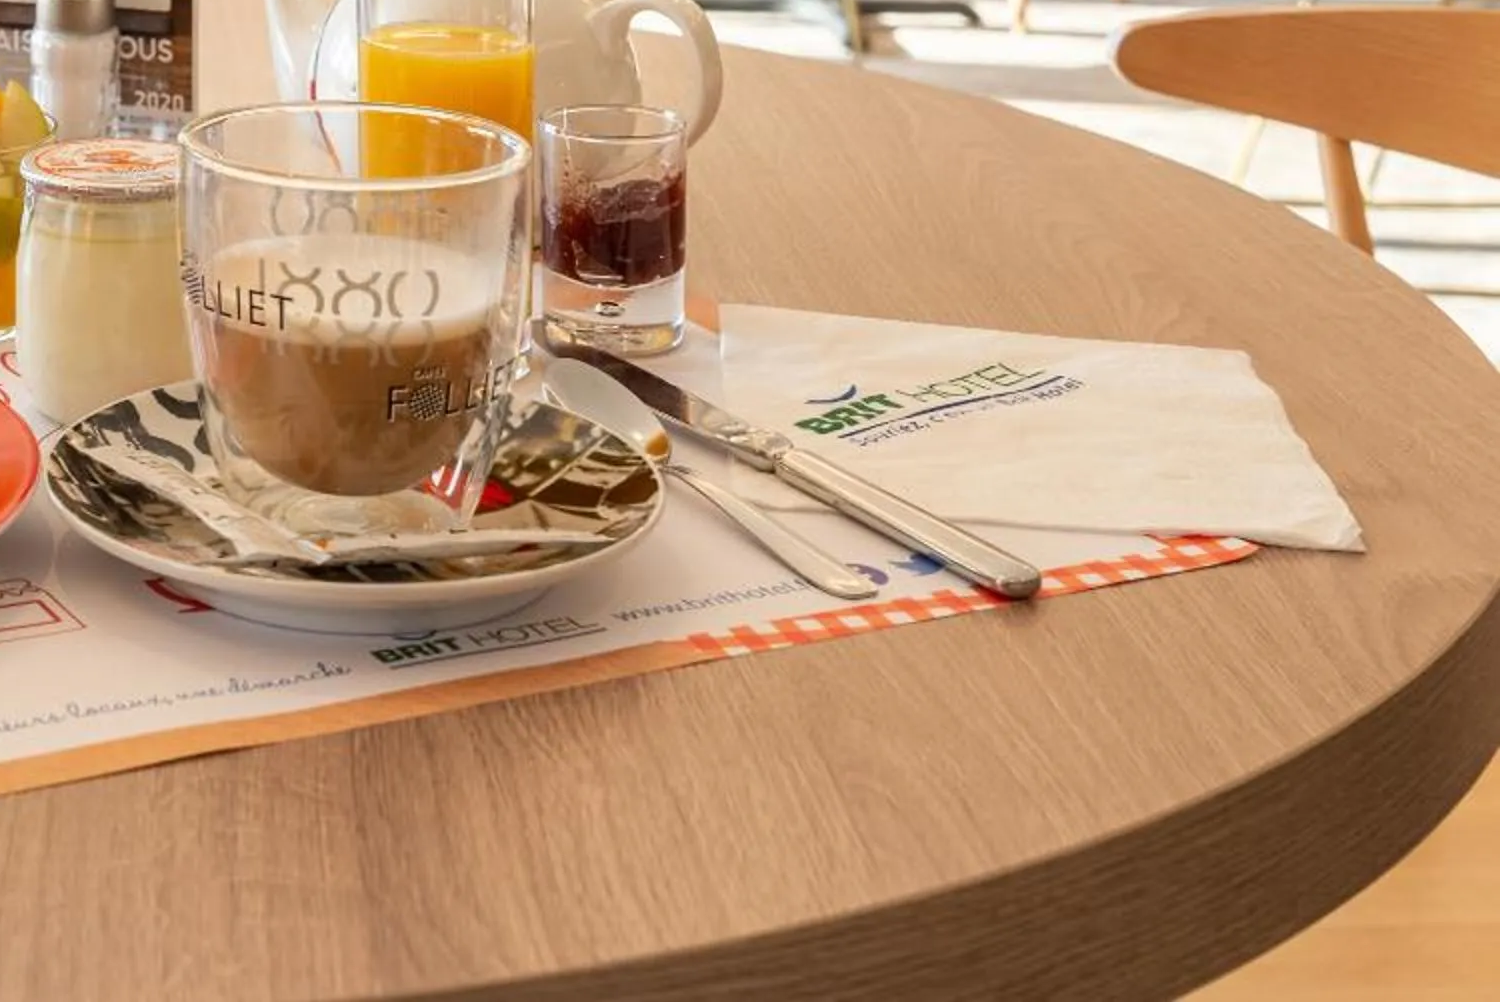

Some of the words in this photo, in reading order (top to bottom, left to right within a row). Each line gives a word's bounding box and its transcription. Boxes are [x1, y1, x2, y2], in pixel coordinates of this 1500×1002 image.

[794, 393, 904, 436] BRIT
[895, 362, 1046, 403] HOTEL
[371, 636, 462, 664] BRIT
[467, 615, 601, 648] HOTEL
